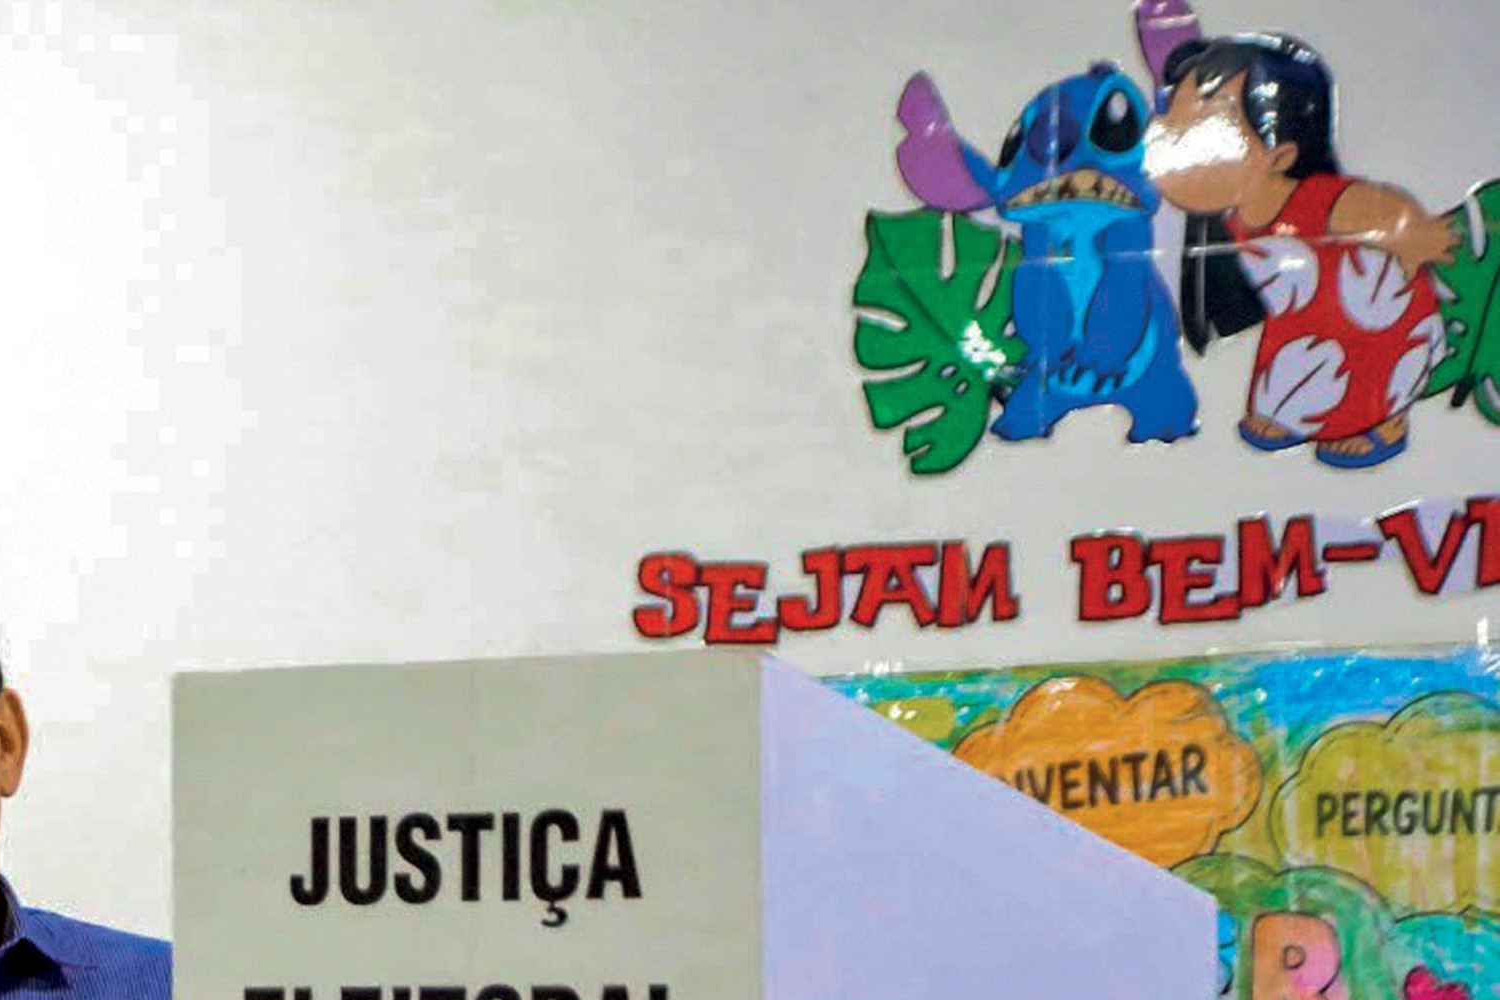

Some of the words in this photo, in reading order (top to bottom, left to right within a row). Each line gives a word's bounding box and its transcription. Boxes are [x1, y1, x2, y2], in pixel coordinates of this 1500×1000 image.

[632, 542, 1020, 644] SEJAM
[1315, 786, 1500, 837] PERGUNT
[290, 808, 642, 928] JUSTIÇA
